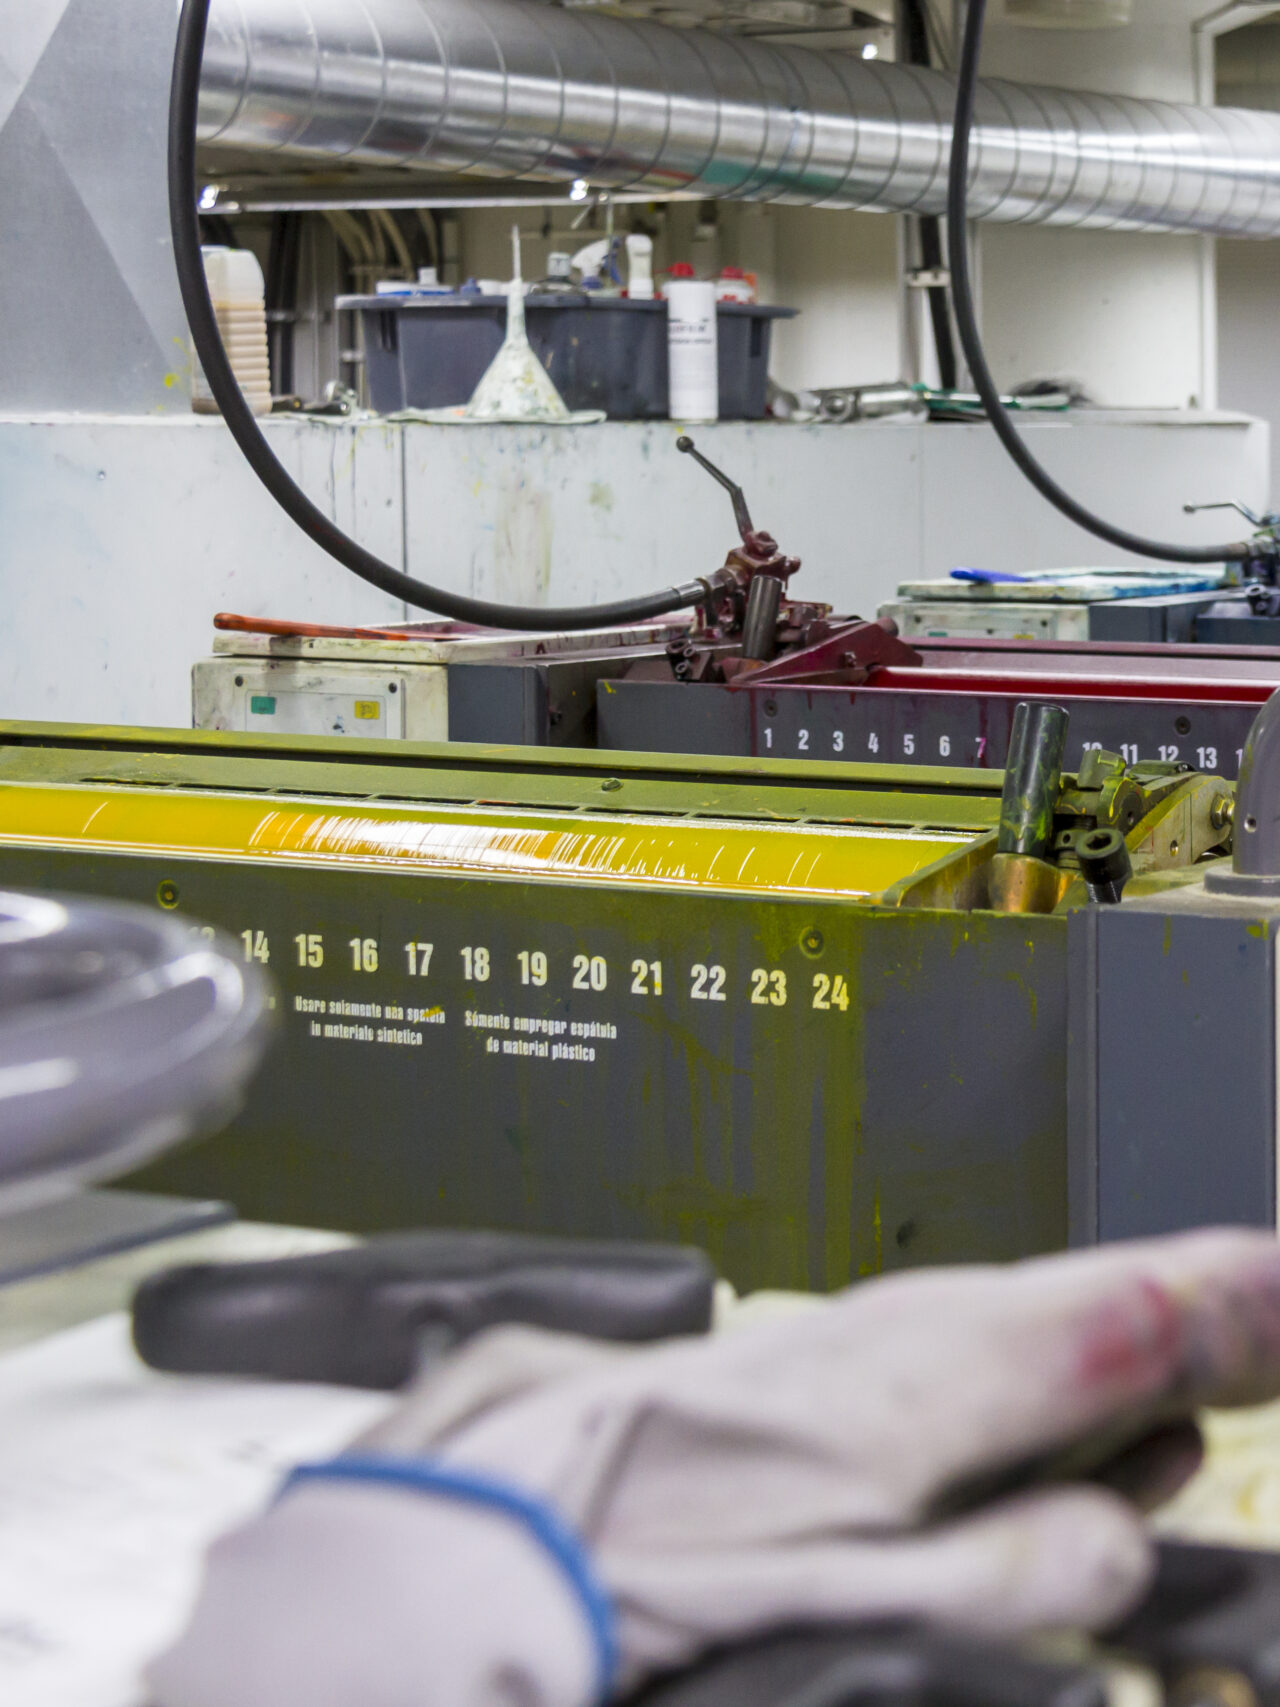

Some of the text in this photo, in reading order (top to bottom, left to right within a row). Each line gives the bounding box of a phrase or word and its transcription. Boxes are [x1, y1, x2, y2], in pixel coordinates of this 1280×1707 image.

[764, 728, 772, 748] 1
[799, 729, 809, 750] 2
[833, 731, 844, 752] 3
[868, 732, 879, 753] 4
[904, 734, 914, 755] 5
[939, 735, 950, 757] 6
[975, 737, 986, 758] 7
[1120, 744, 1138, 765] 11
[1158, 745, 1179, 762] 12
[1196, 747, 1217, 769] 13
[241, 929, 270, 964] 14
[294, 933, 324, 968] 15
[349, 938, 378, 973] 16
[405, 942, 434, 977] 17
[461, 946, 490, 982] 18
[517, 951, 548, 987] 19
[572, 954, 607, 992] 20
[631, 959, 662, 996] 21
[690, 964, 726, 1001] 22
[751, 968, 787, 1007] 23
[812, 972, 849, 1012] 24
[295, 995, 326, 1013] Usare
[329, 1000, 382, 1018] solamente
[385, 1005, 404, 1020] una
[311, 1020, 423, 1045] in materiale sintetico
[465, 1010, 617, 1039] Sómente empregar espátula
[486, 1036, 596, 1062] de material plástico
